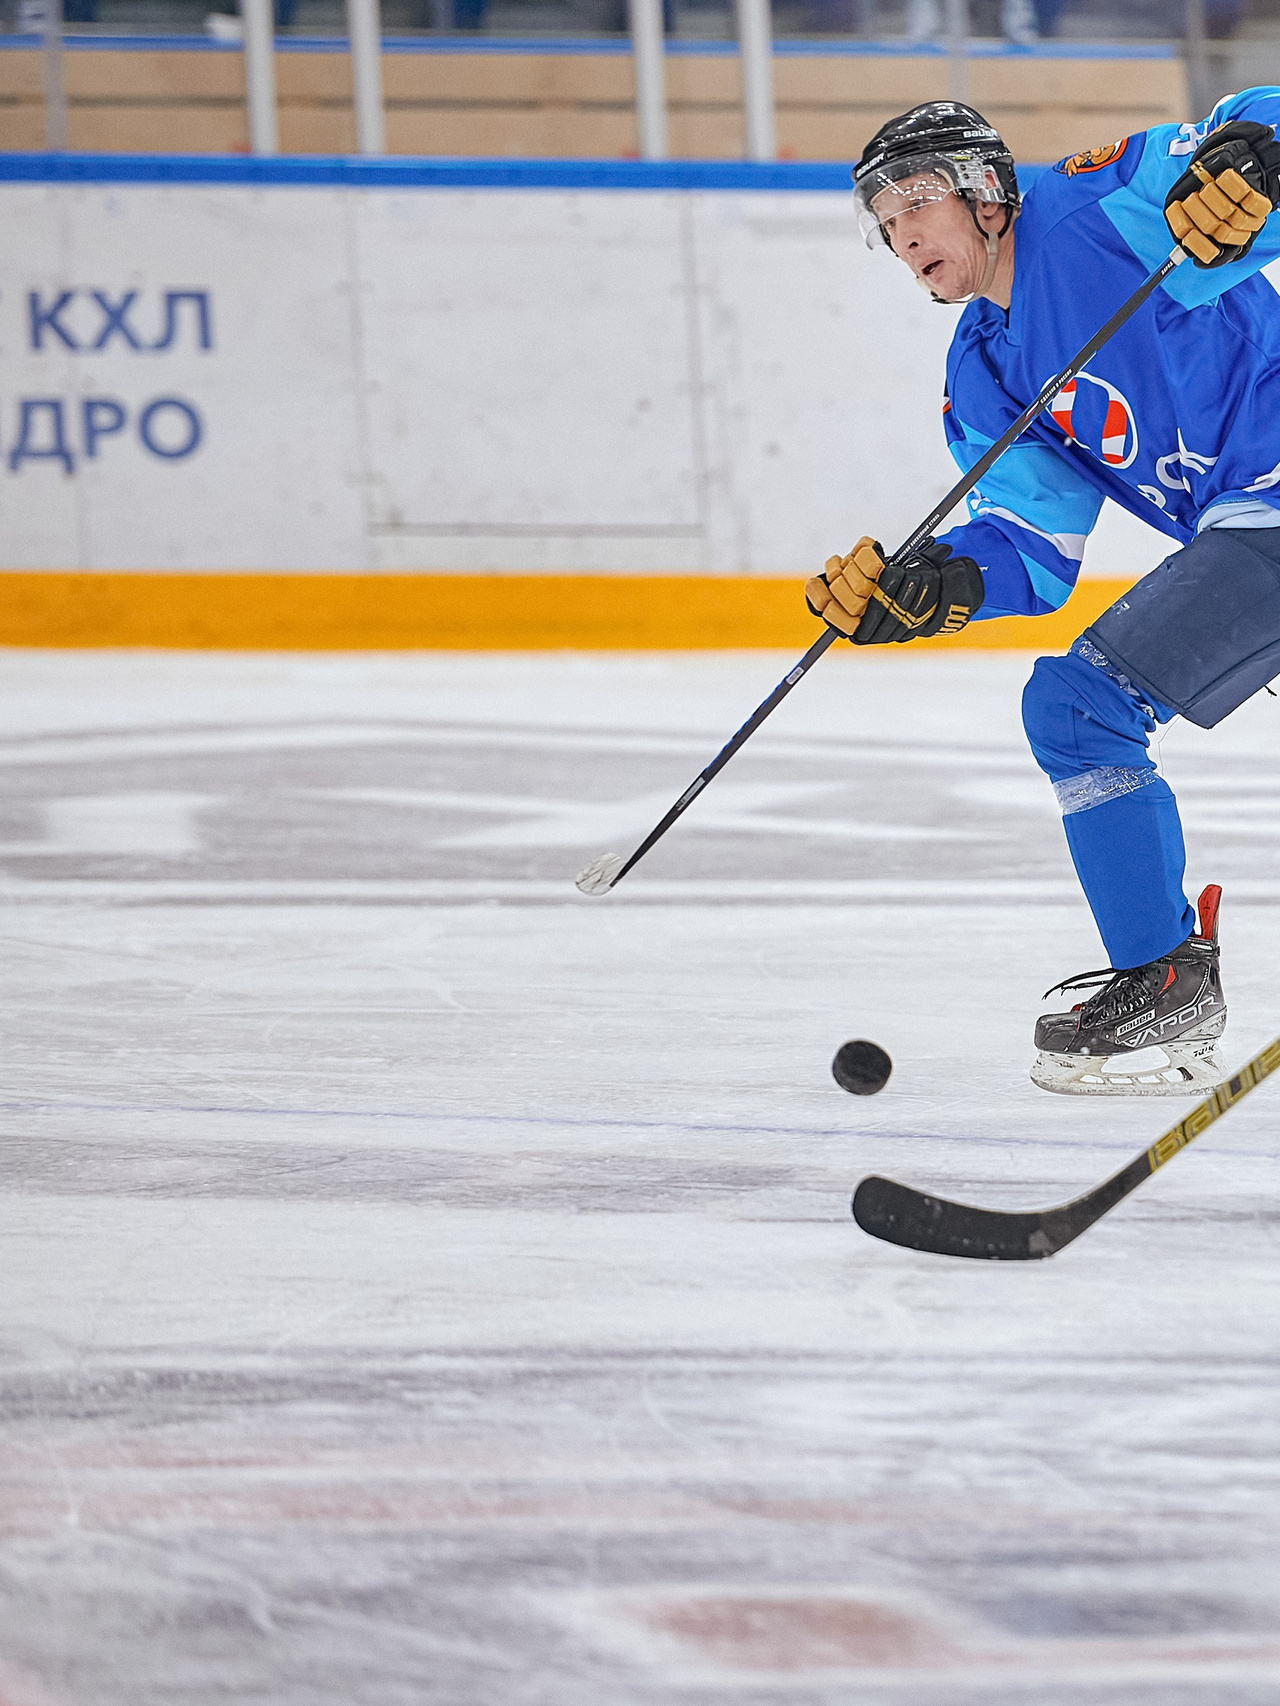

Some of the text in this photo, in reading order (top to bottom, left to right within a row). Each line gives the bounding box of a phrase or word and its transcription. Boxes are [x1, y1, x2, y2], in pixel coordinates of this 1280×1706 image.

[26, 287, 214, 353] КХЛ
[4, 397, 205, 474] ДРО
[1118, 1010, 1154, 1036] BAUER
